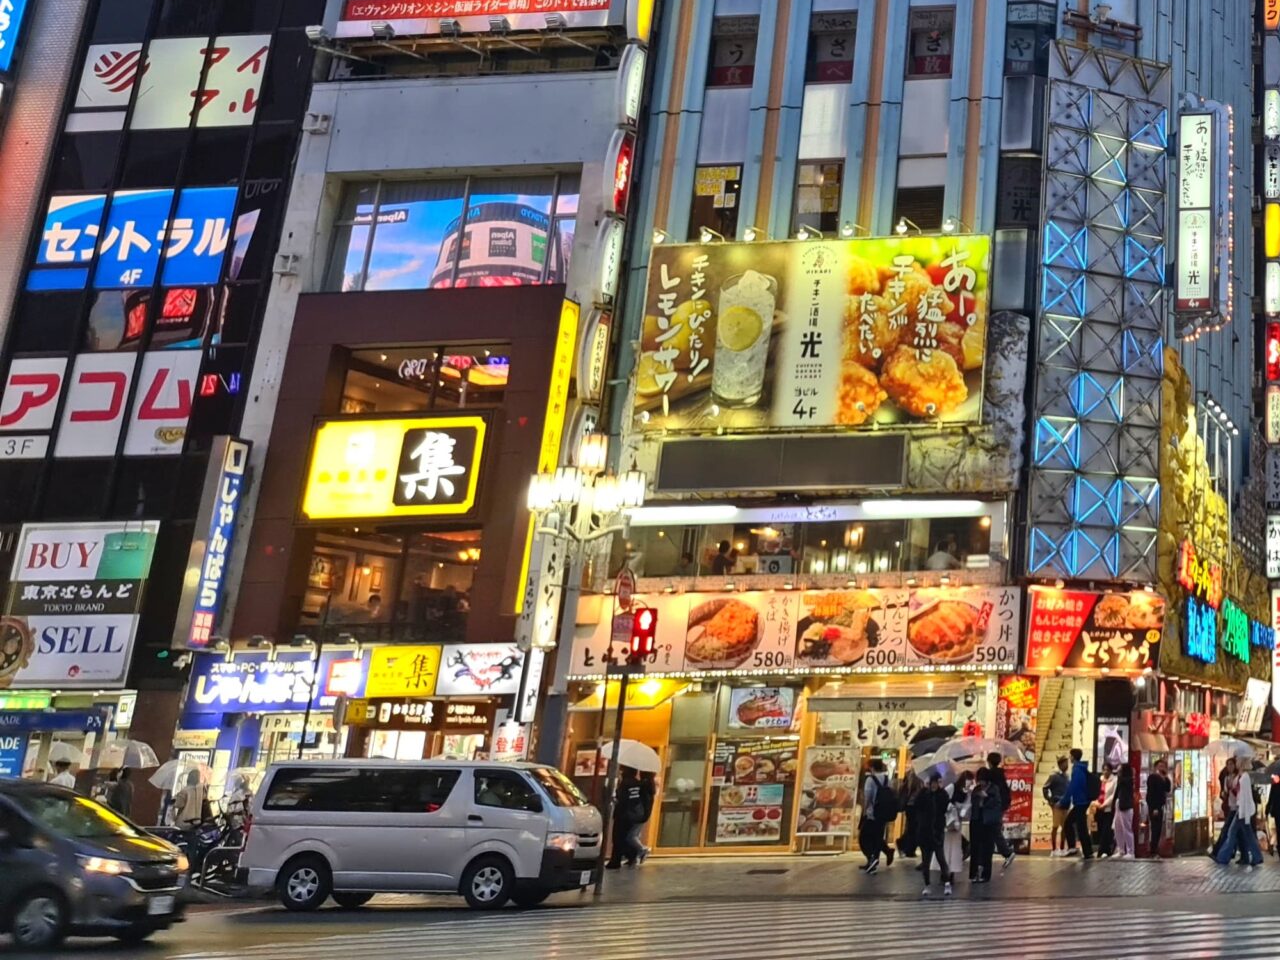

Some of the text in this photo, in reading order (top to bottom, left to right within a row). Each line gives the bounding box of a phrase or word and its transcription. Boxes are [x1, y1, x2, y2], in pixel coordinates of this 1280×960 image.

[43, 218, 231, 263] セントラル
[120, 269, 143, 285] 4F
[1188, 270, 1201, 286] 光
[888, 255, 916, 331] チキンが
[915, 291, 947, 362] 猛烈に
[652, 264, 682, 417] レモンサワー
[800, 331, 823, 359] 光
[0, 368, 193, 426] アコム
[792, 398, 818, 420] 4F
[5, 440, 34, 456] 3F
[400, 431, 467, 500] 集
[25, 541, 100, 570] BUY
[43, 602, 105, 613] TOKYO BRAND
[766, 597, 777, 622] そば
[998, 590, 1016, 643] かつ丼
[1037, 598, 1084, 611] お好み焼き
[777, 595, 793, 647] かき揚げ
[1035, 615, 1083, 628] もんじゃ焼き
[37, 625, 126, 657] SELL
[1032, 630, 1073, 643] 焼きそば
[753, 650, 792, 667] 580円
[865, 649, 905, 666] 600円
[975, 645, 1015, 663] 590円
[405, 653, 433, 688] 集
